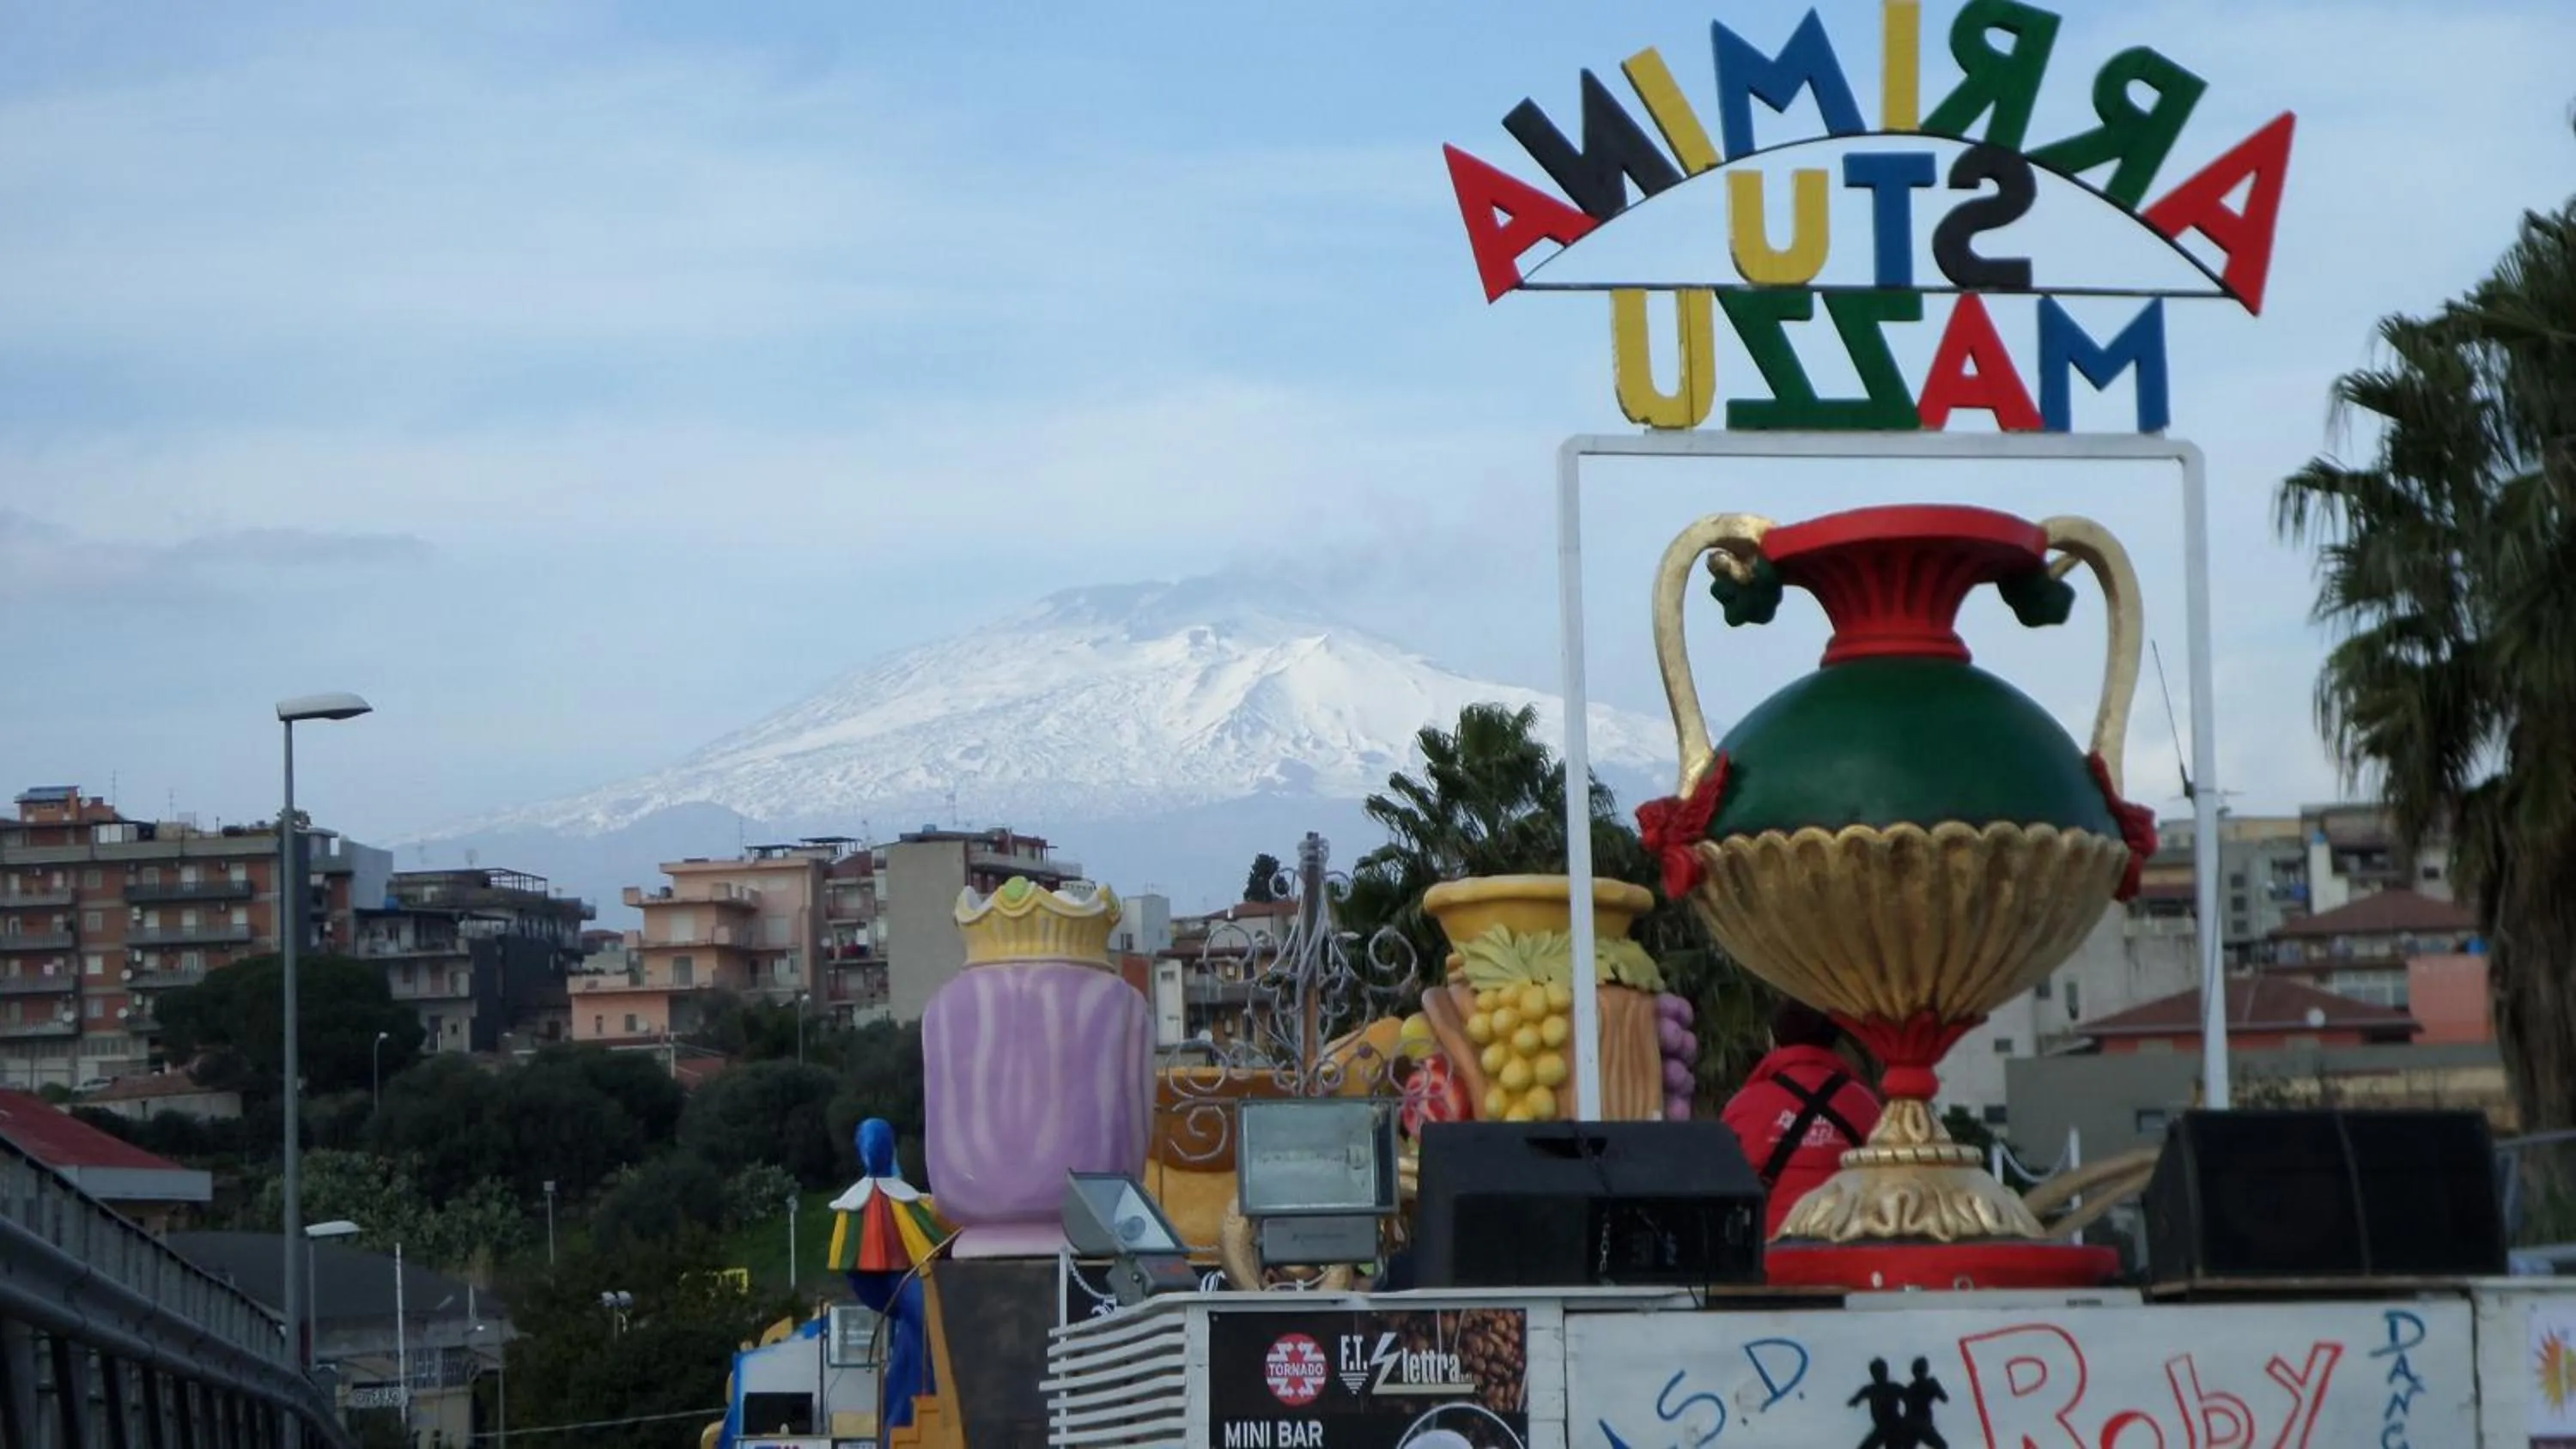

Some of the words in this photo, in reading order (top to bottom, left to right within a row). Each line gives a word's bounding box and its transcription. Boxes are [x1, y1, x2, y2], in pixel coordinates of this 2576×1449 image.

[1268, 1362, 1324, 1377] TORNADO
[1224, 1422, 1270, 1449] MINI
[1278, 1422, 1323, 1447] BAR
